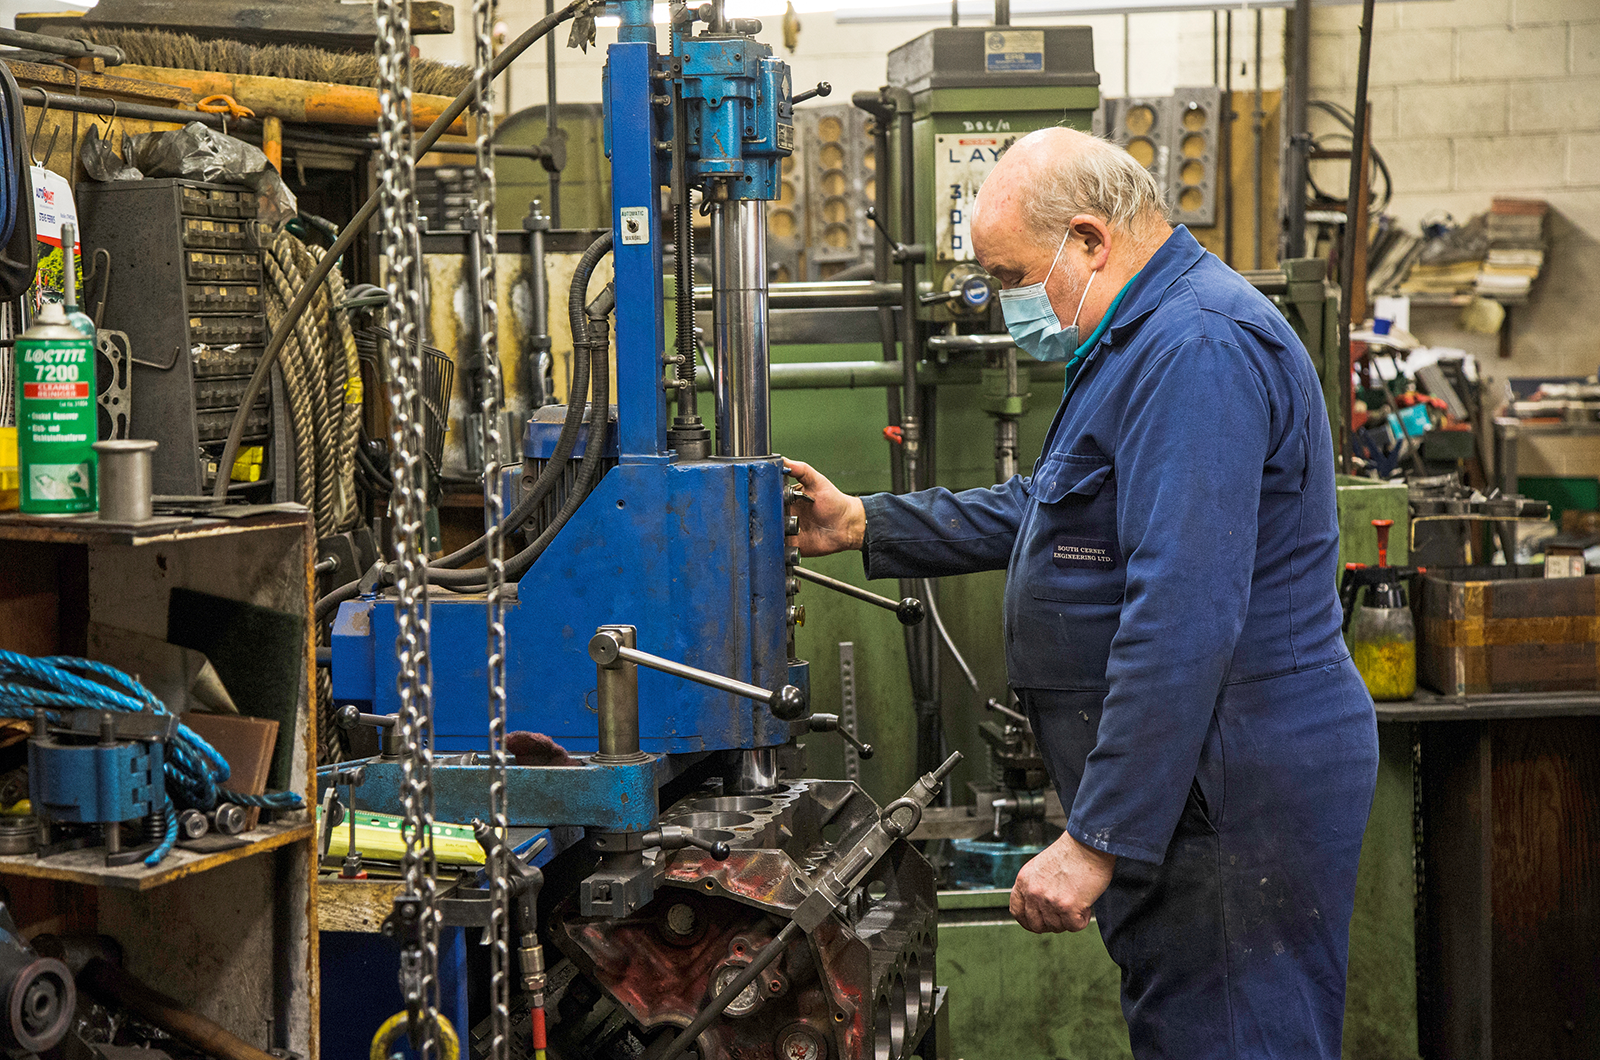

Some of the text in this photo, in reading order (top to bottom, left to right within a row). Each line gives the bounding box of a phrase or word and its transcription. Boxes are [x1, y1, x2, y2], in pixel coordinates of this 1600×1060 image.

[24, 348, 87, 363] LOCTITE
[34, 364, 79, 382] 7200
[37, 383, 76, 391] CLEANER
[37, 390, 76, 398] REINIGER
[1053, 552, 1096, 560] ENGINEERING
